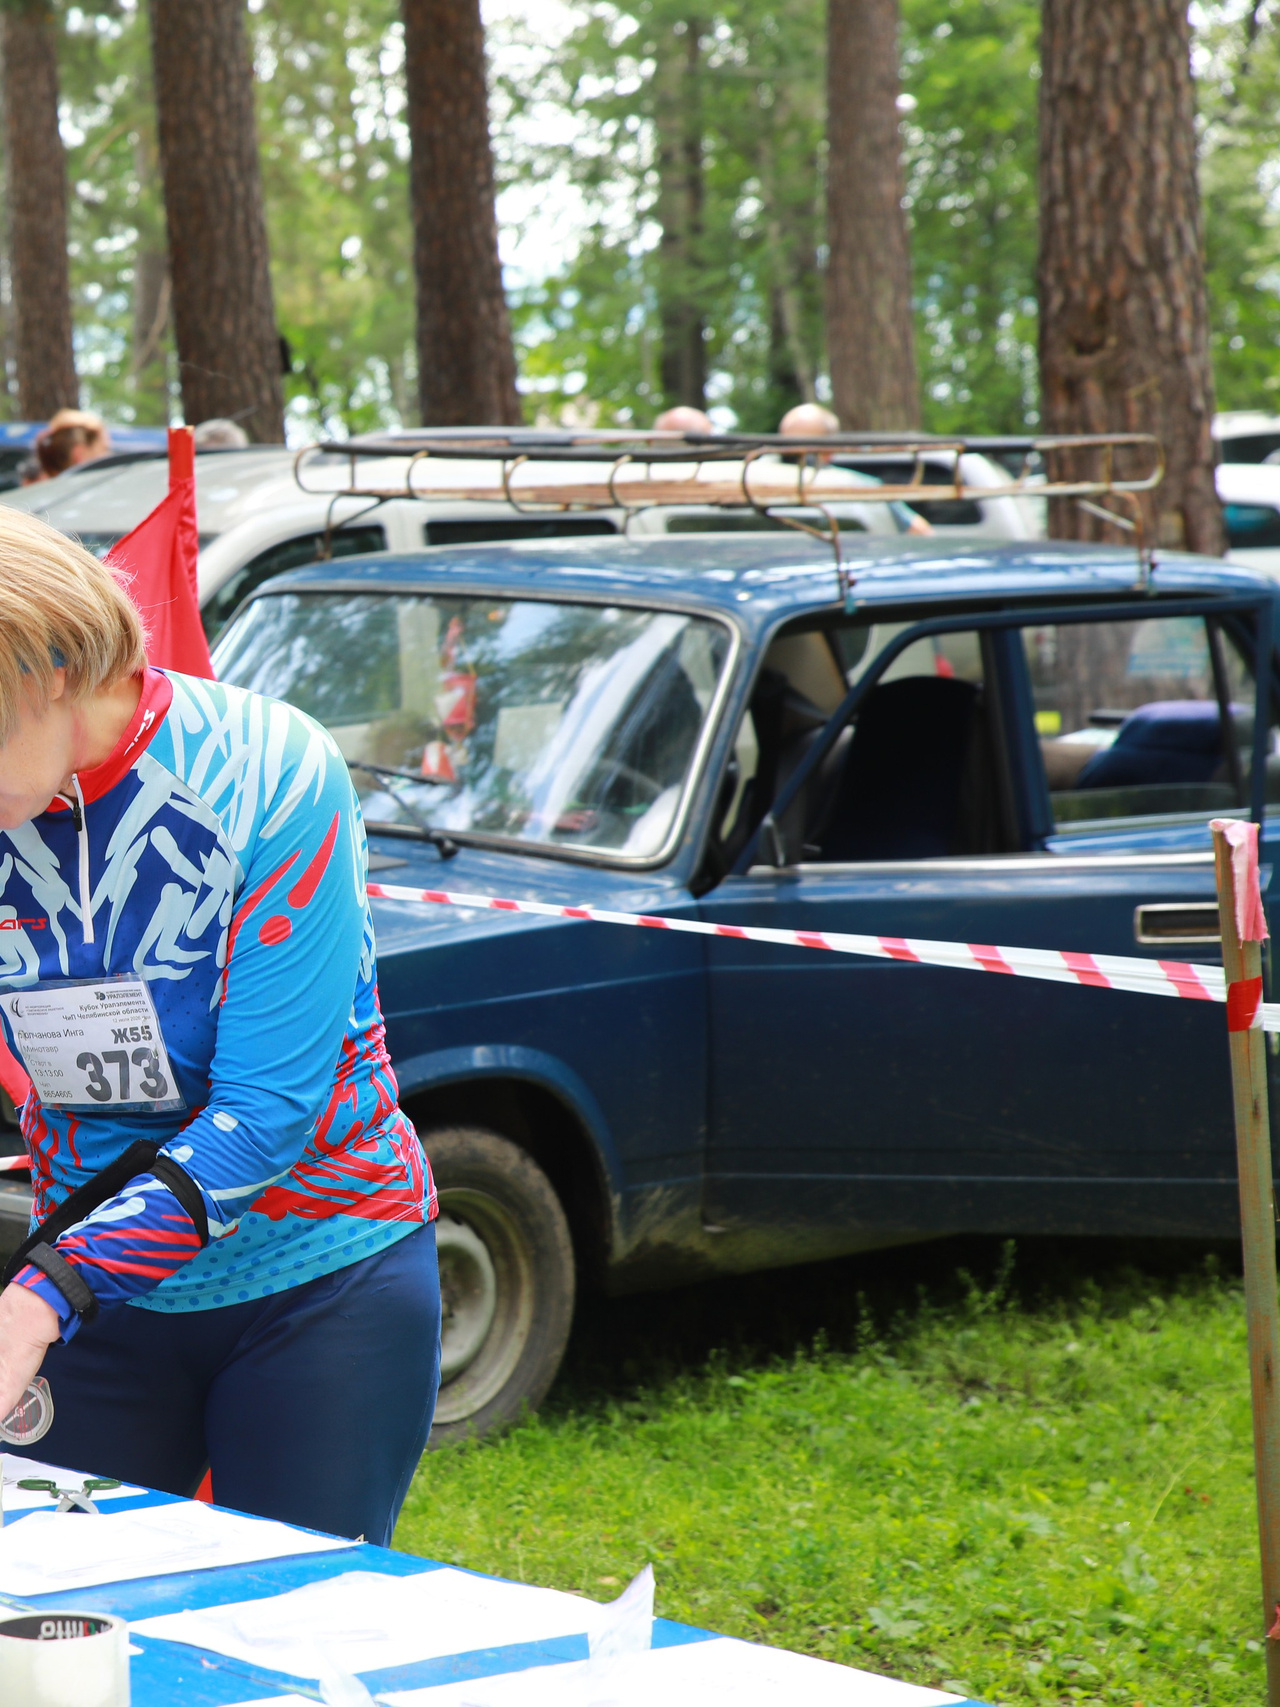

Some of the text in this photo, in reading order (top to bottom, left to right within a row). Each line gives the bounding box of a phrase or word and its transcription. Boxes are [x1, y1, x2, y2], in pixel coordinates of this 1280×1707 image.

[79, 1000, 146, 1012] Кубок Уралэлемента
[77, 1010, 121, 1020] Челябинской
[122, 1007, 149, 1015] области
[62, 1028, 84, 1038] Инга
[111, 1025, 153, 1044] Ж55
[76, 1047, 169, 1103] 373
